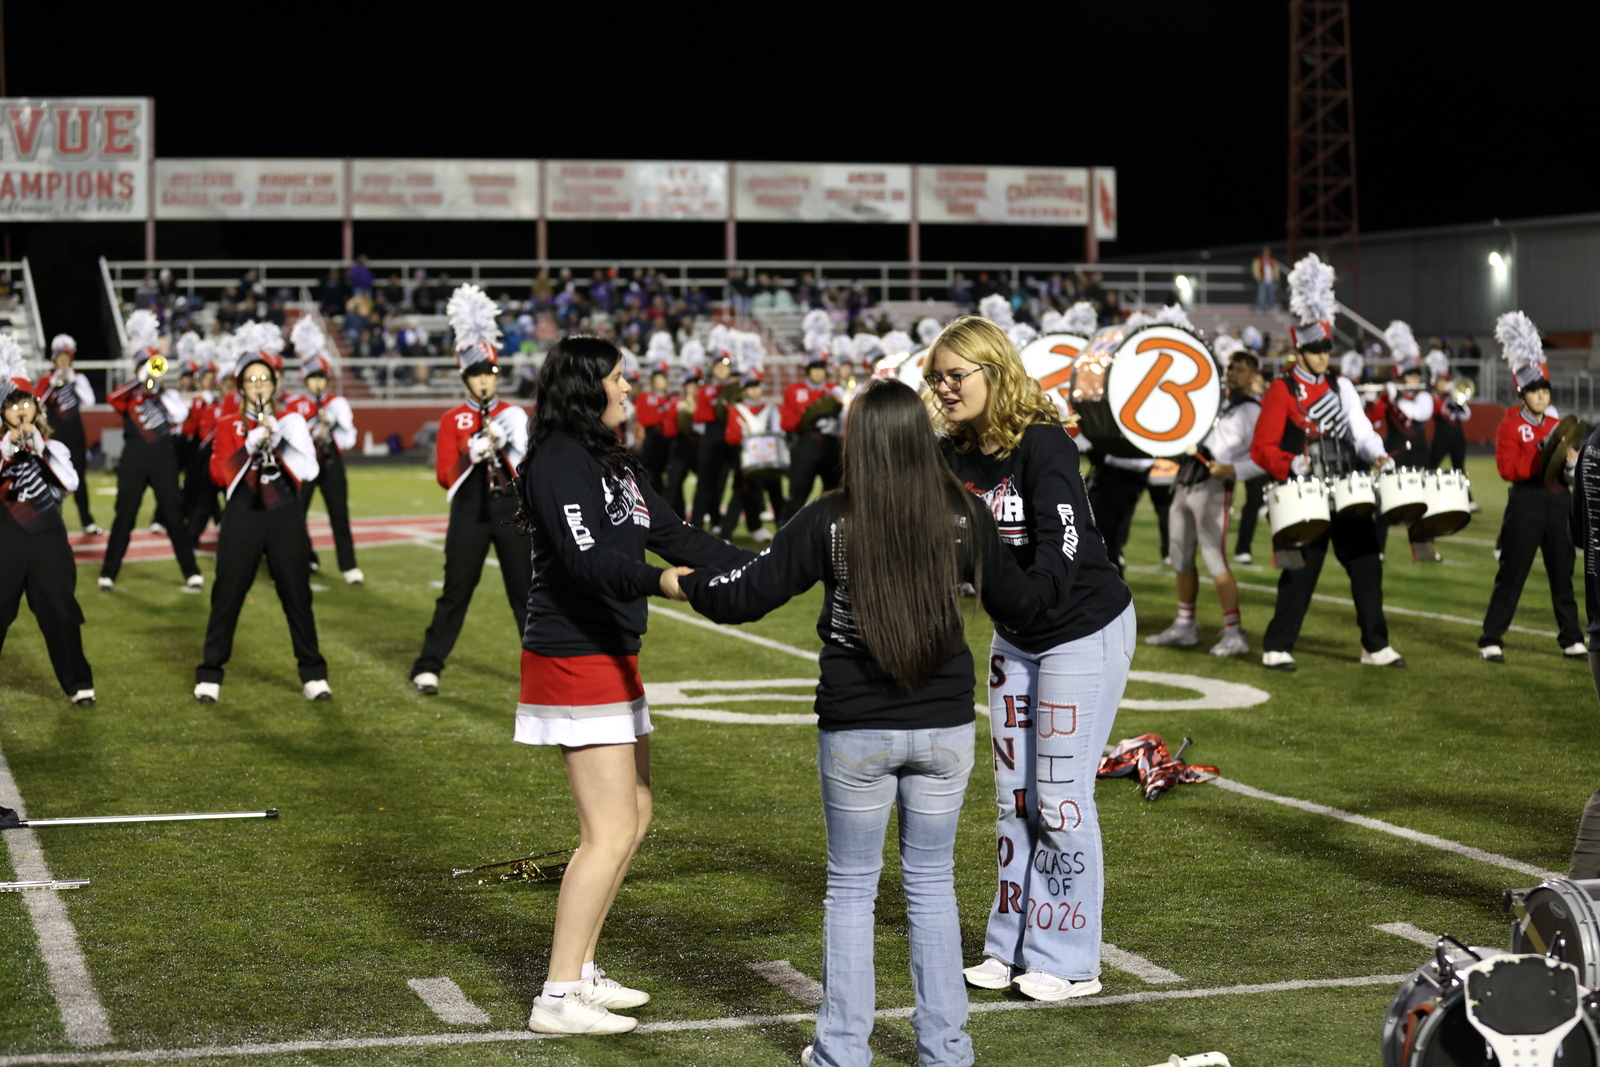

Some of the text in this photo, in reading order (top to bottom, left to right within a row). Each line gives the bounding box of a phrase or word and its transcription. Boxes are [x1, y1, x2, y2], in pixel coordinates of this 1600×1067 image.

[1119, 337, 1212, 442] B
[454, 412, 474, 430] B
[1517, 423, 1535, 442] B
[989, 654, 1034, 914] SENIOR
[1034, 849, 1085, 875] CLASS
[1048, 877, 1072, 896] OF
[1027, 898, 1086, 931] 2026
